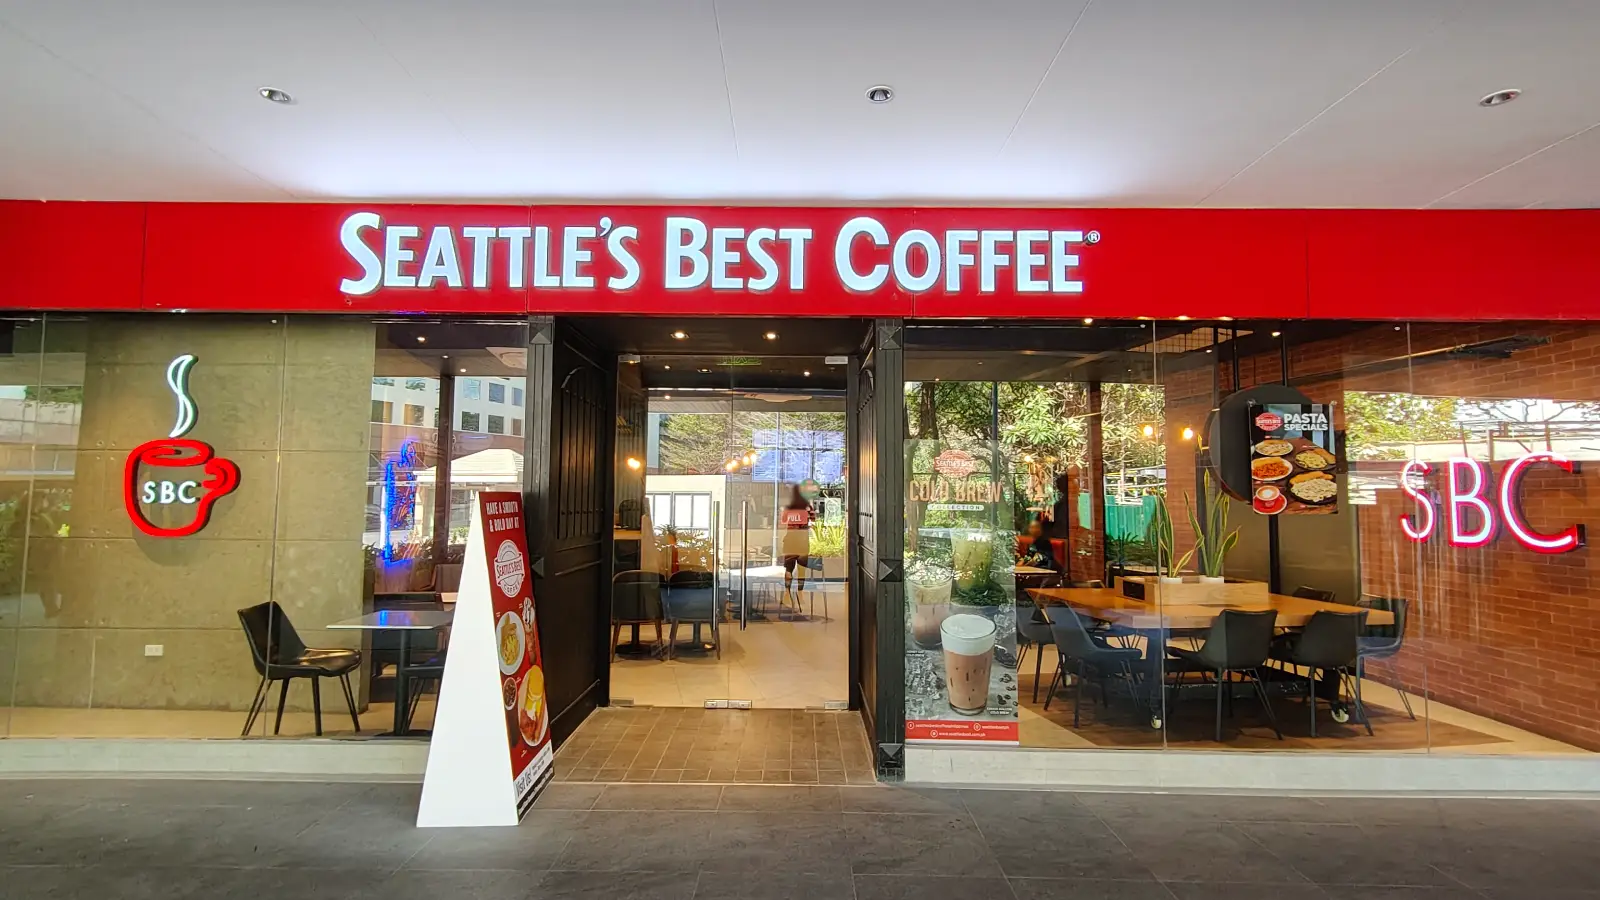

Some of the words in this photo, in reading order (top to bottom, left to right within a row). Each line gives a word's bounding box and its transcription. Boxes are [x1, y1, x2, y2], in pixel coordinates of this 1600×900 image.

[339, 211, 641, 295] SEATTLE'S
[664, 216, 812, 291] BEST
[1284, 413, 1327, 423] PASTA
[142, 480, 197, 504] SBC
[909, 479, 950, 502] COLD
[955, 480, 1002, 502] BREW
[1398, 449, 1586, 554] SBC
[788, 513, 802, 522] PULL
